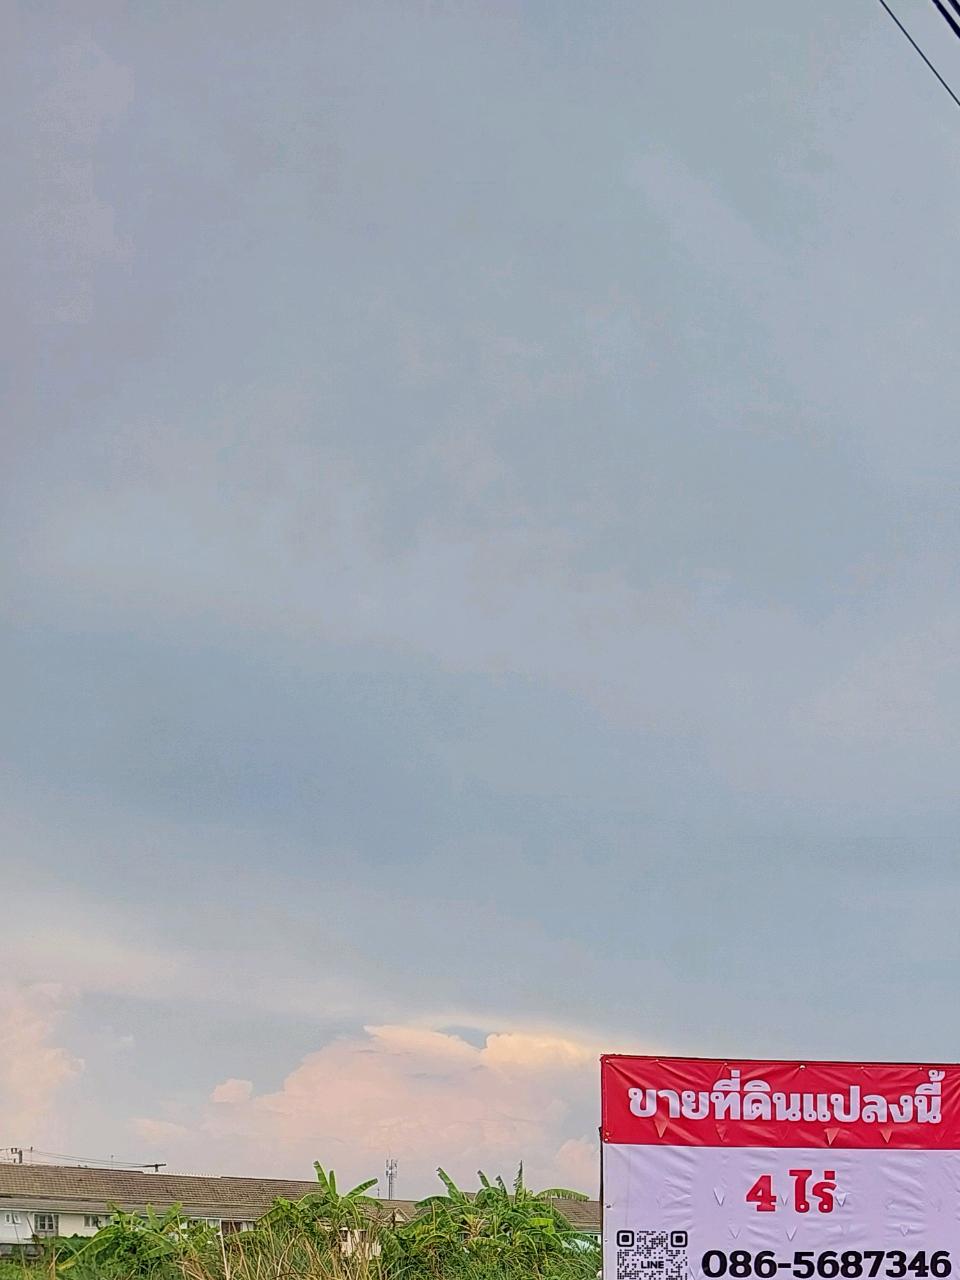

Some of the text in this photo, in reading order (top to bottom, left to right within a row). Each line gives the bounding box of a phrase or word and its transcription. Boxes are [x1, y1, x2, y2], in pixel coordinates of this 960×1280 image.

[628, 1069, 946, 1124] ขายที่ดินแปลงนี้
[746, 1169, 837, 1213] 4 ไร่
[640, 1260, 665, 1269] LINE
[701, 1250, 952, 1279] 086-5687346
